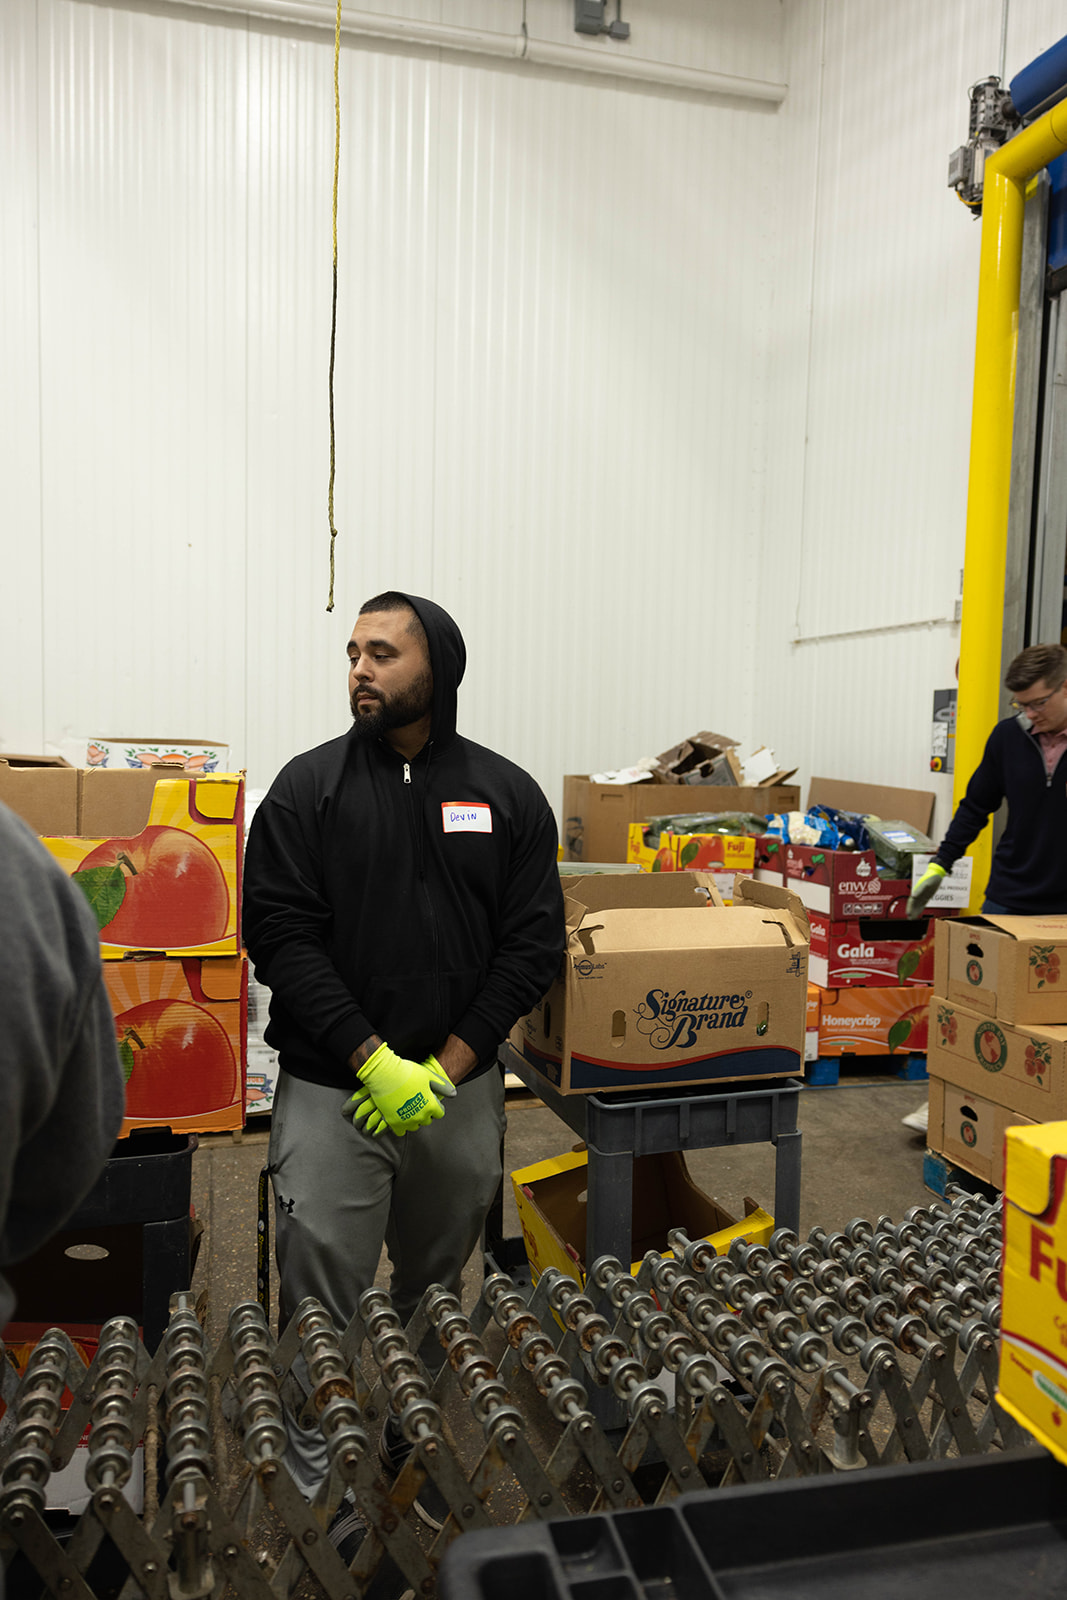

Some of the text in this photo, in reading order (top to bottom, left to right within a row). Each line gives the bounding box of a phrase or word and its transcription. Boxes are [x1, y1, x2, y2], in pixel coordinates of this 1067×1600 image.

[727, 841, 746, 854] Fuji
[838, 880, 868, 897] envy
[932, 894, 954, 902] GGIES
[809, 922, 826, 937] Gala
[837, 943, 875, 959] Gala
[634, 988, 746, 1022] Signature
[649, 1005, 748, 1050] Brand
[822, 1014, 881, 1029] Honeycrisp
[400, 1099, 428, 1121] SOURCE
